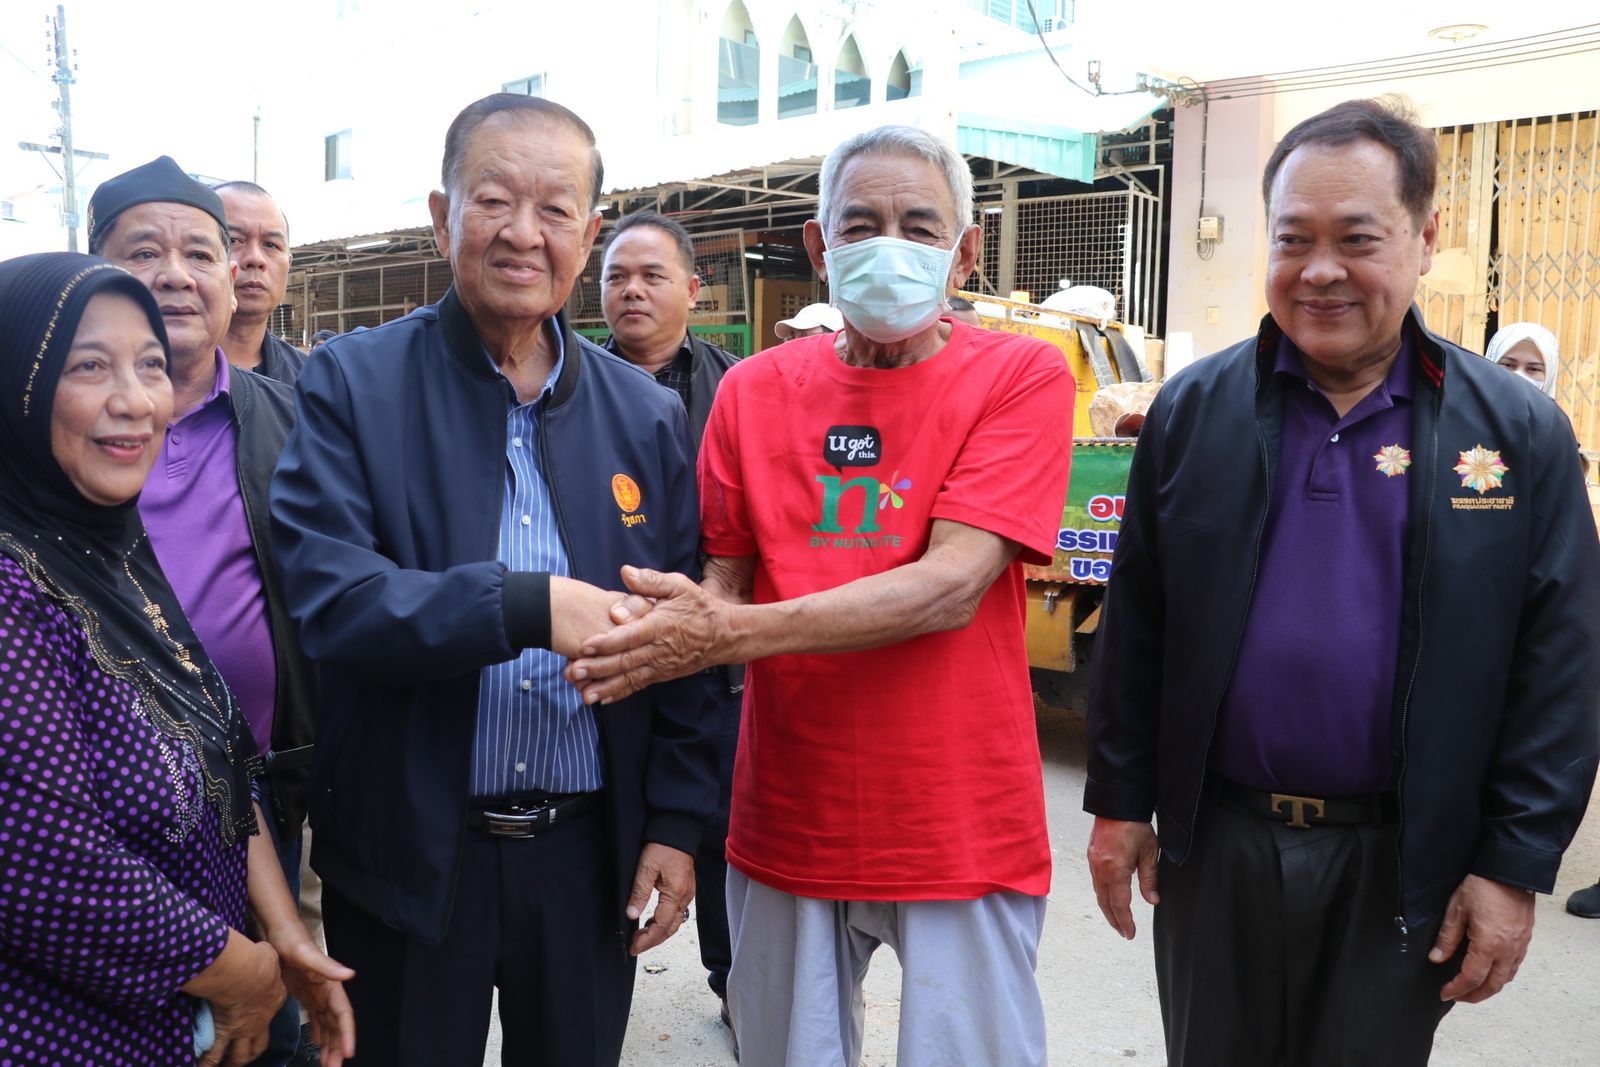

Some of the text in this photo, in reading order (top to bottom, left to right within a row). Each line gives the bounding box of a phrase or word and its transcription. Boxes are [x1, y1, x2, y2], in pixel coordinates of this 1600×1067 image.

[847, 433, 875, 461] got
[858, 450, 877, 459] this.
[812, 475, 881, 534] n
[621, 514, 646, 527] รัฐสภา
[809, 536, 830, 547] BY
